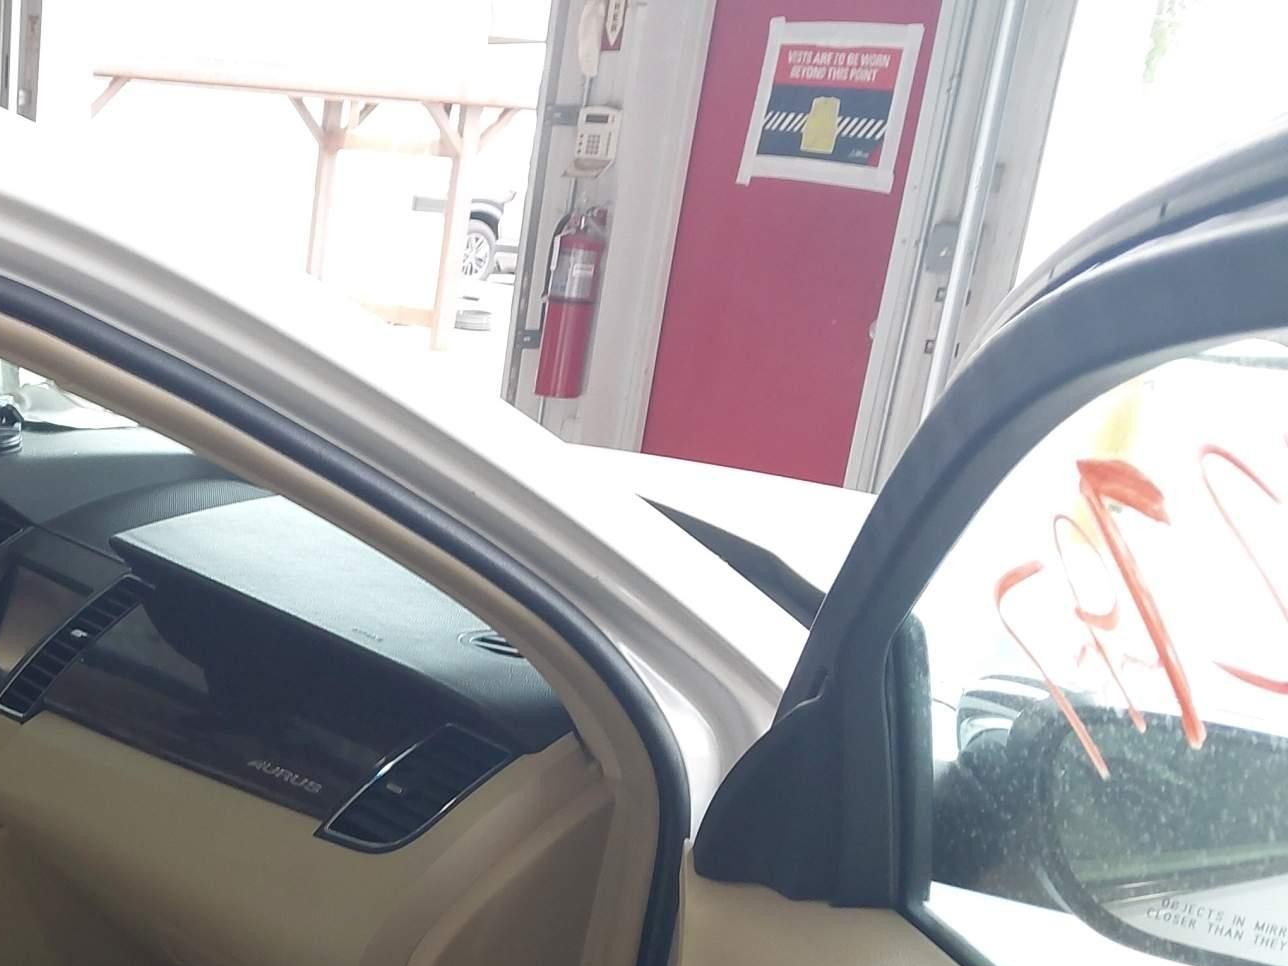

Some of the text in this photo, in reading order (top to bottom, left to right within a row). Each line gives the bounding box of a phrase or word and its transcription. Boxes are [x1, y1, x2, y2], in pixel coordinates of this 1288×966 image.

[812, 51, 834, 66] ARE
[833, 52, 847, 66] TO
[846, 52, 861, 67] BE
[860, 53, 891, 69] WORN
[789, 65, 880, 83] BEYOND THIS POINT
[1161, 898, 1225, 922] OBJECTS
[1232, 914, 1246, 927] IN
[1146, 907, 1288, 951] CLOSER THAN THEY
